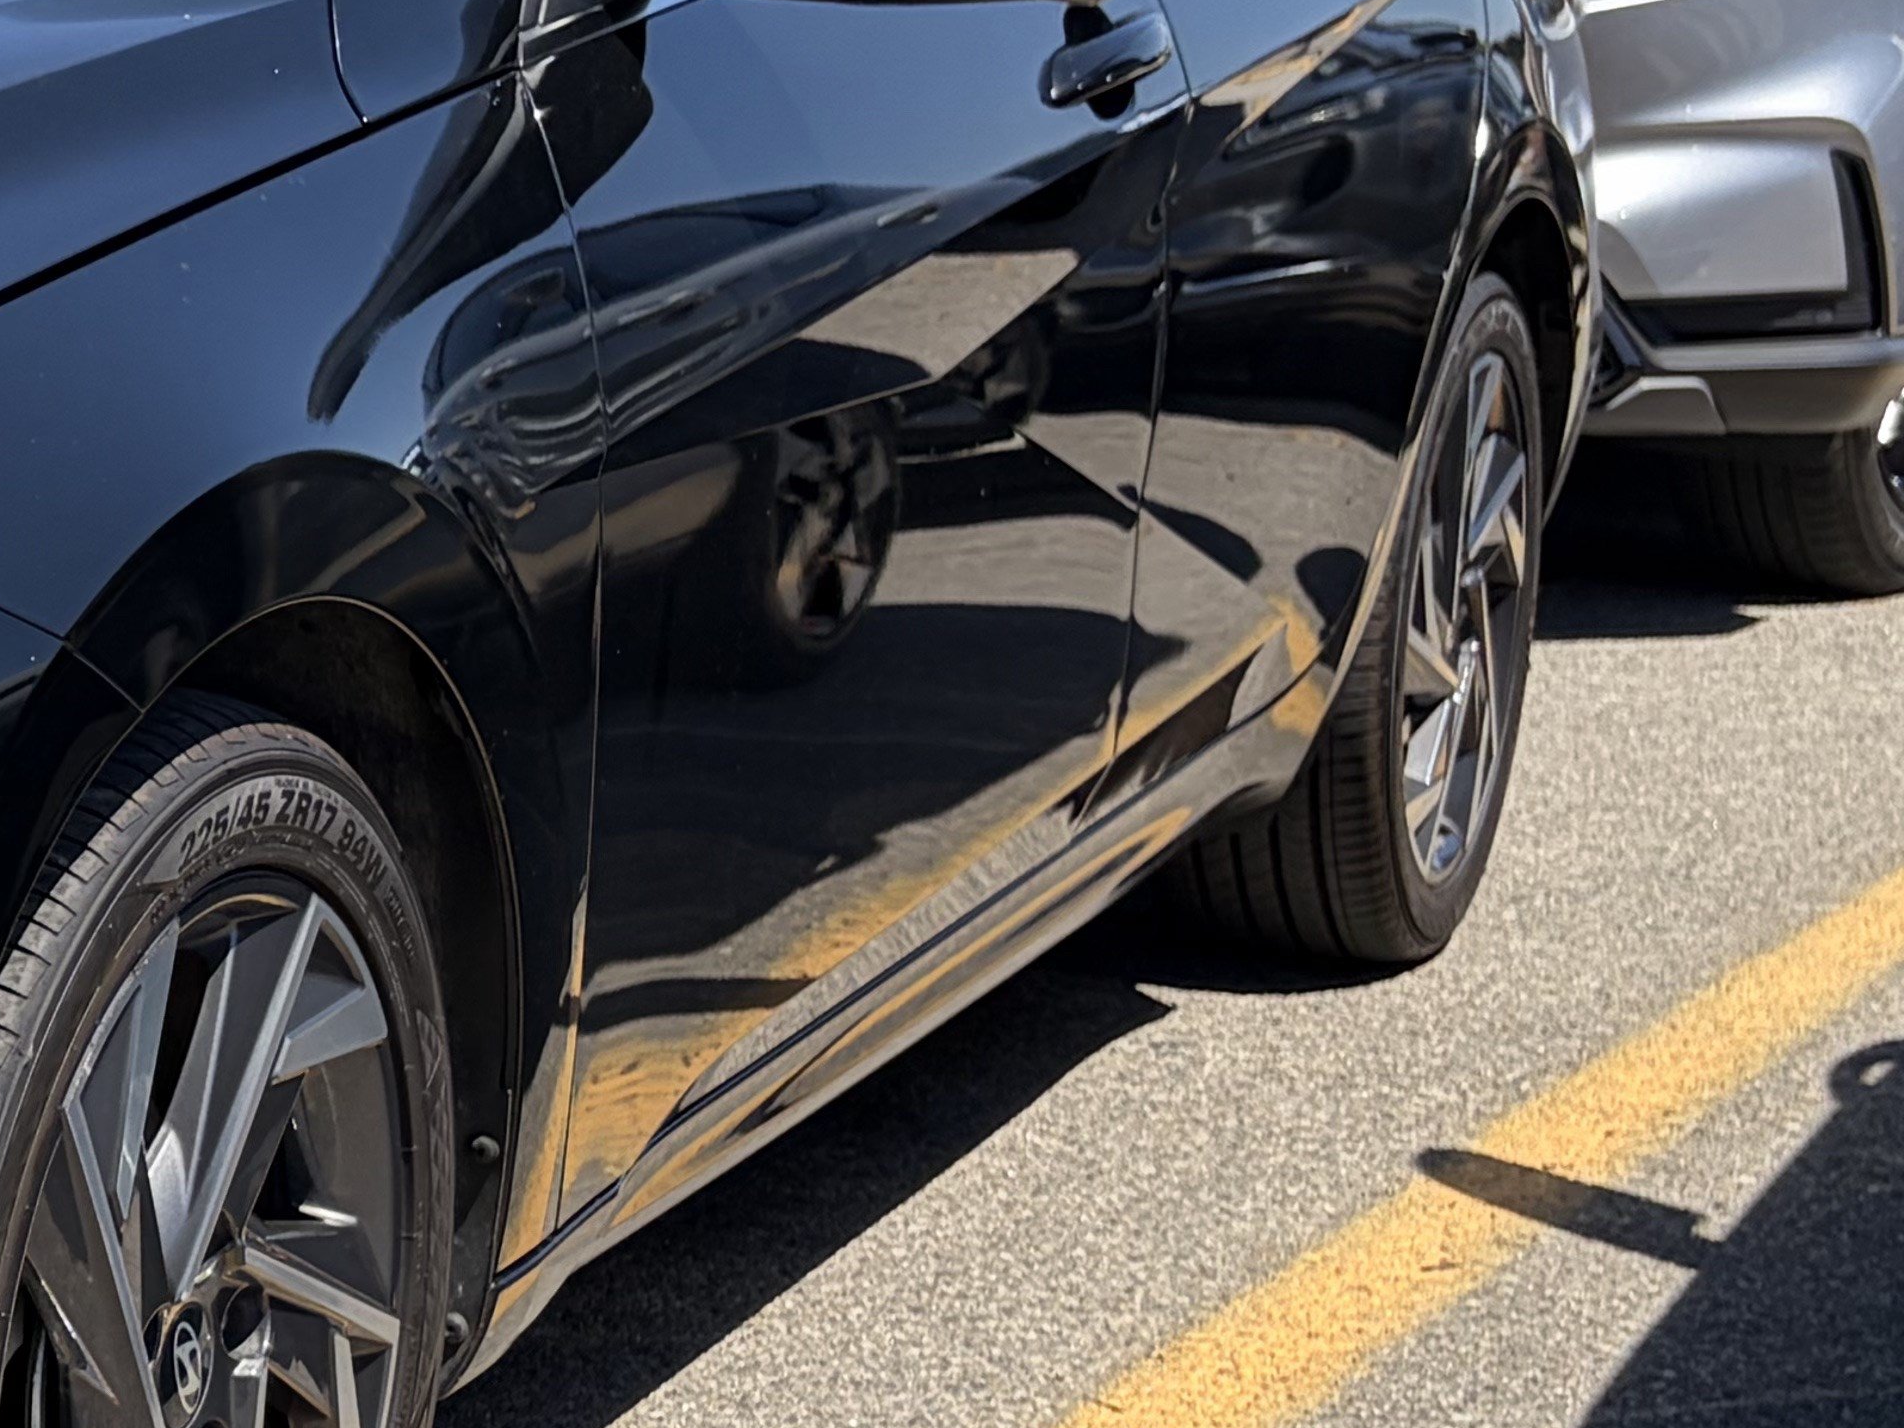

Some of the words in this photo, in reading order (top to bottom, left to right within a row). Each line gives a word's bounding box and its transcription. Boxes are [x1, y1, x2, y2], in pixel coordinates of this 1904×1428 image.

[178, 788, 273, 874] 225/45
[274, 789, 339, 838] ZR17
[337, 819, 389, 890] 94W
